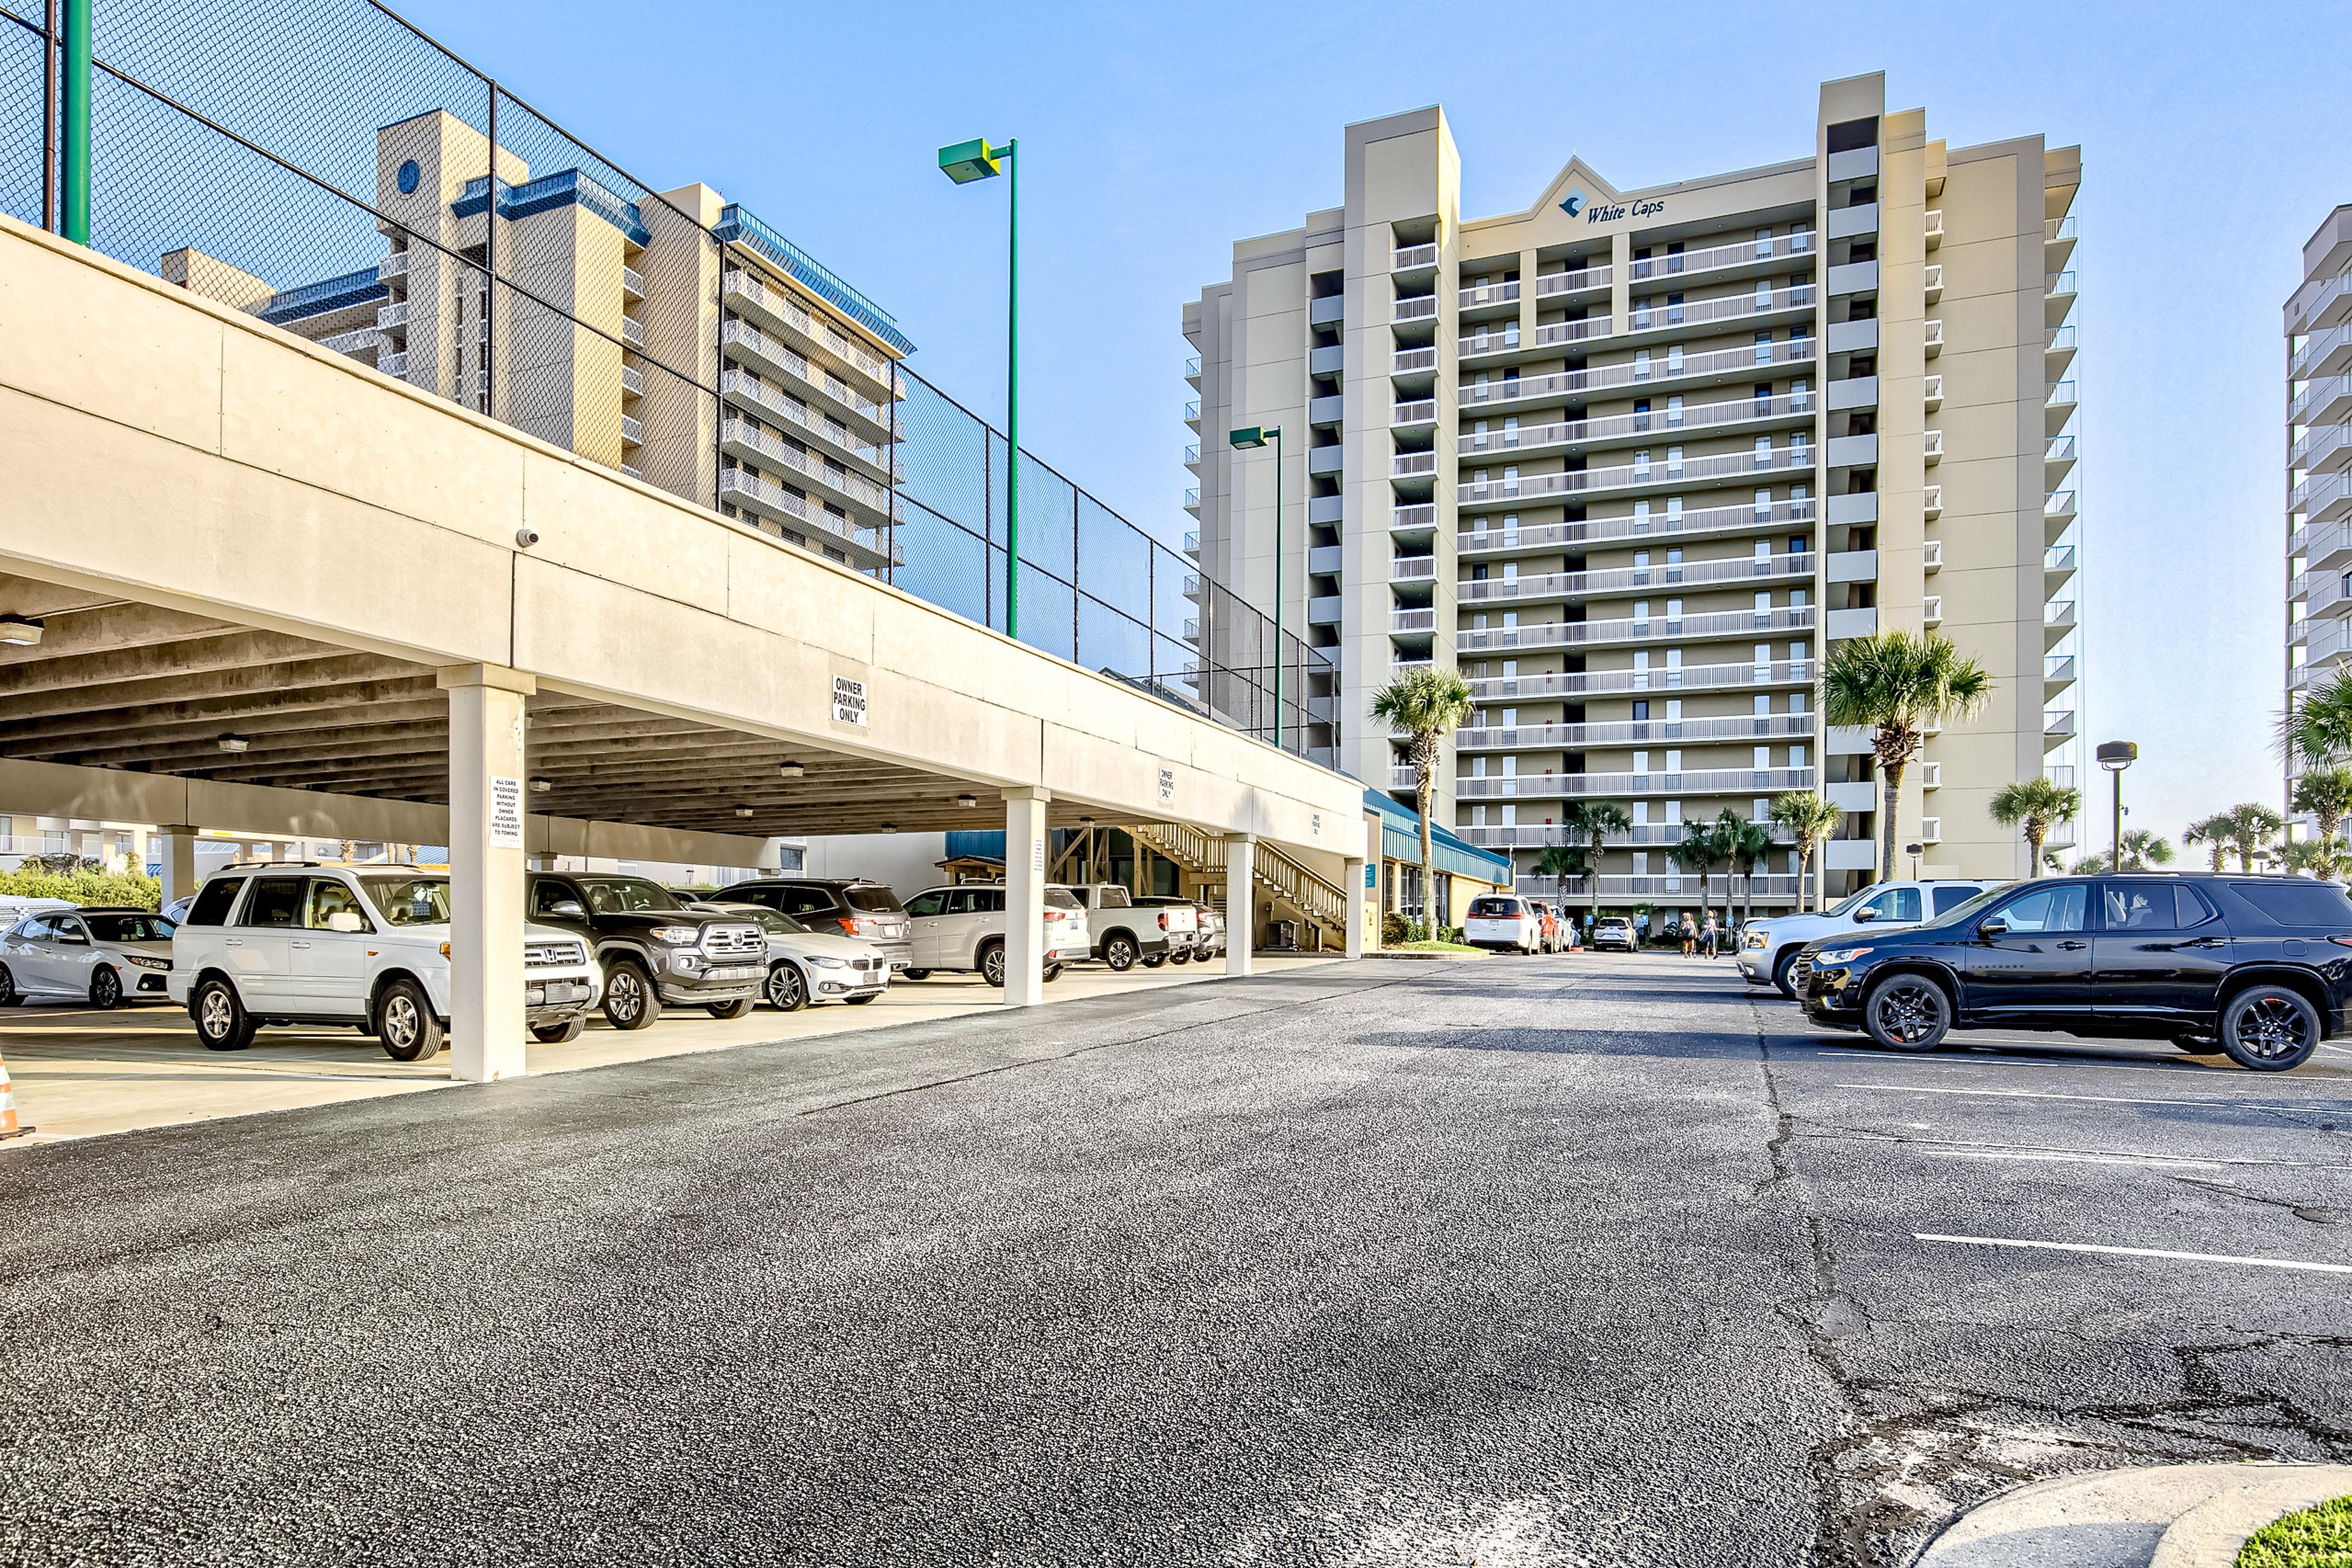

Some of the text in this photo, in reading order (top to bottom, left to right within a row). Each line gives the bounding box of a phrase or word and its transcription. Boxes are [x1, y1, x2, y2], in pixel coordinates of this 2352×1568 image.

[1587, 200, 1665, 224] White Caps
[836, 678, 862, 696] OWNER
[834, 691, 865, 711] PARKING
[840, 708, 859, 723] ONLY
